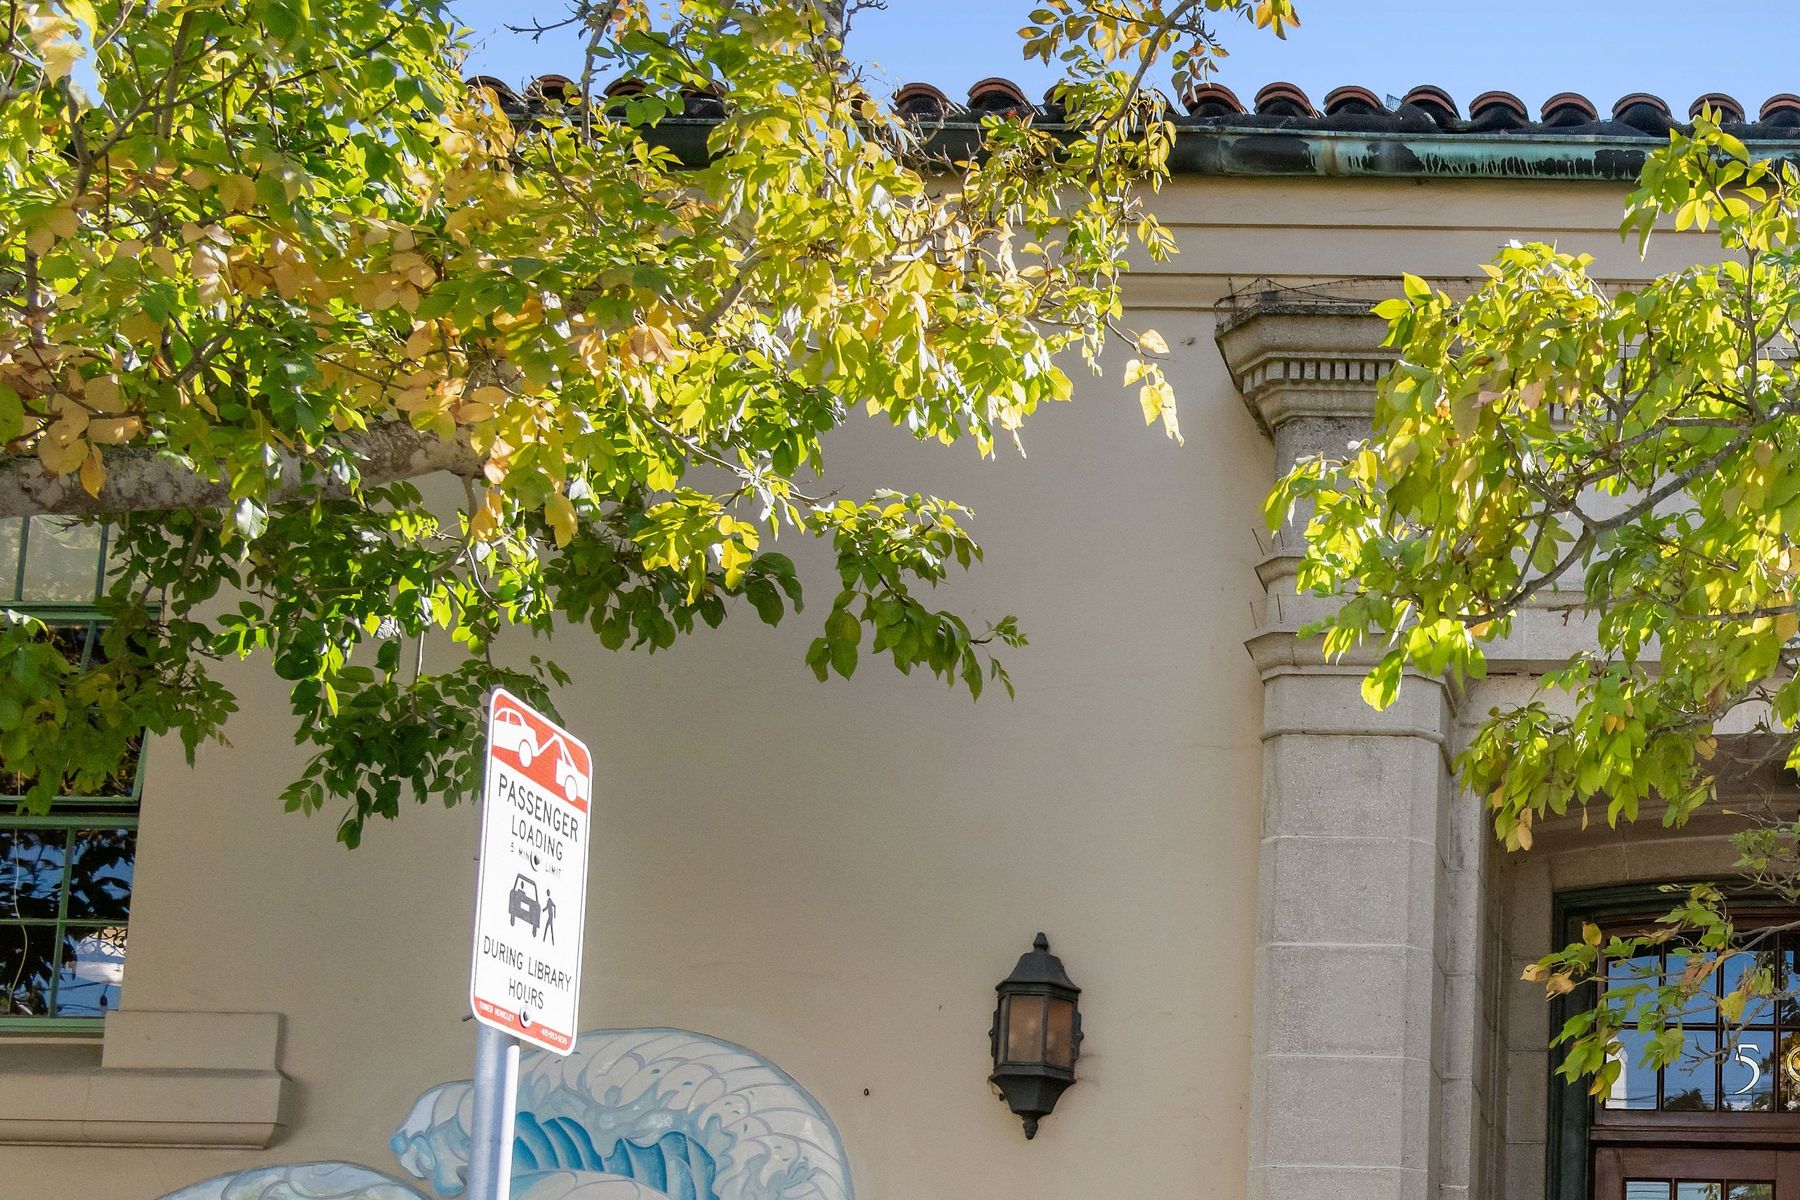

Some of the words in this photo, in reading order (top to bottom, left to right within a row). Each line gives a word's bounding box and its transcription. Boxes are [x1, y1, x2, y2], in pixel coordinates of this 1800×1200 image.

[498, 772, 579, 843] PASSENGER
[511, 814, 563, 861] LOADING
[483, 935, 524, 971] DURING
[528, 957, 572, 992] LIBRARY
[508, 977, 544, 1010] HOURS
